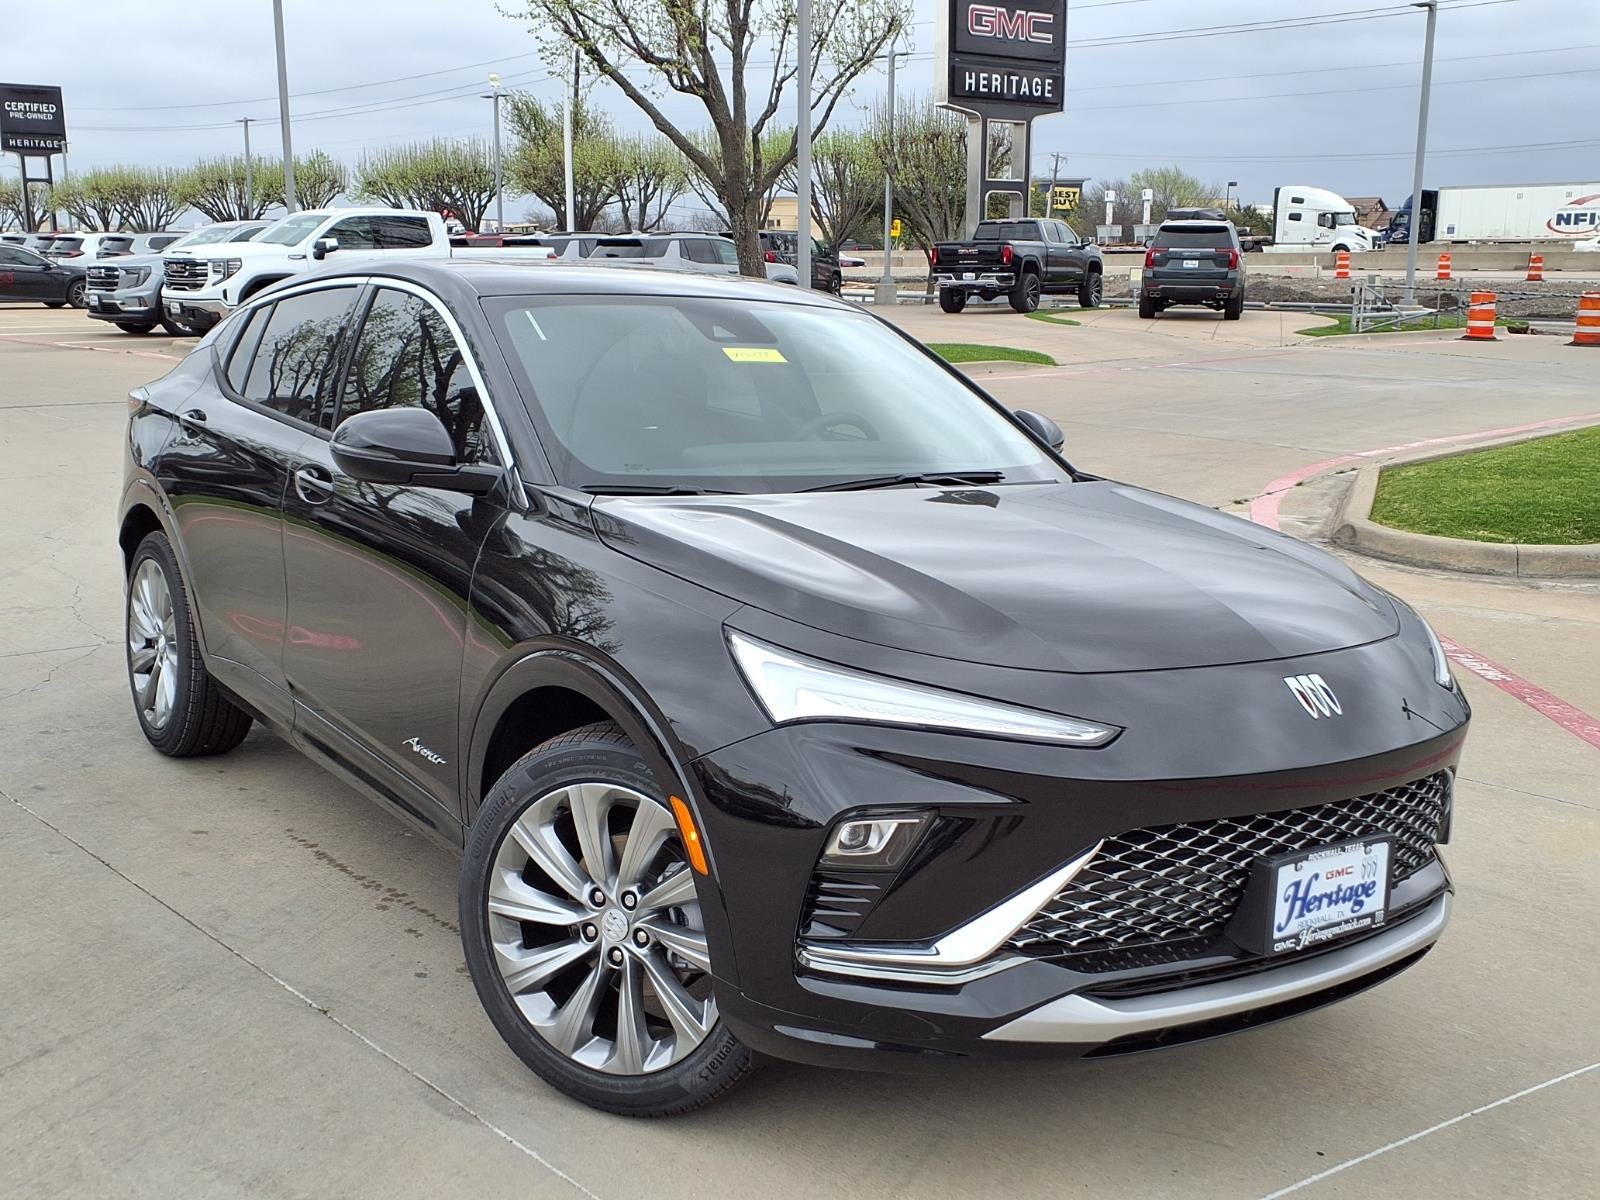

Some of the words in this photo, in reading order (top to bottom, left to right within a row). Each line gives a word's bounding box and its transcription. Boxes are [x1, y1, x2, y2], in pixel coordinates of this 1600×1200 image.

[968, 4, 1053, 44] GMC
[965, 71, 1052, 98] HERITAGE
[4, 101, 57, 113] CERTIFIED
[9, 111, 53, 120] PRE-OWNED
[9, 138, 60, 148] HERITAGE
[1053, 190, 1078, 199] BEST
[1053, 198, 1076, 207] BUY
[1555, 212, 1596, 226] NFI
[1325, 866, 1354, 880] GMC
[1276, 872, 1376, 933] Heritage
[1274, 939, 1296, 952] GMC
